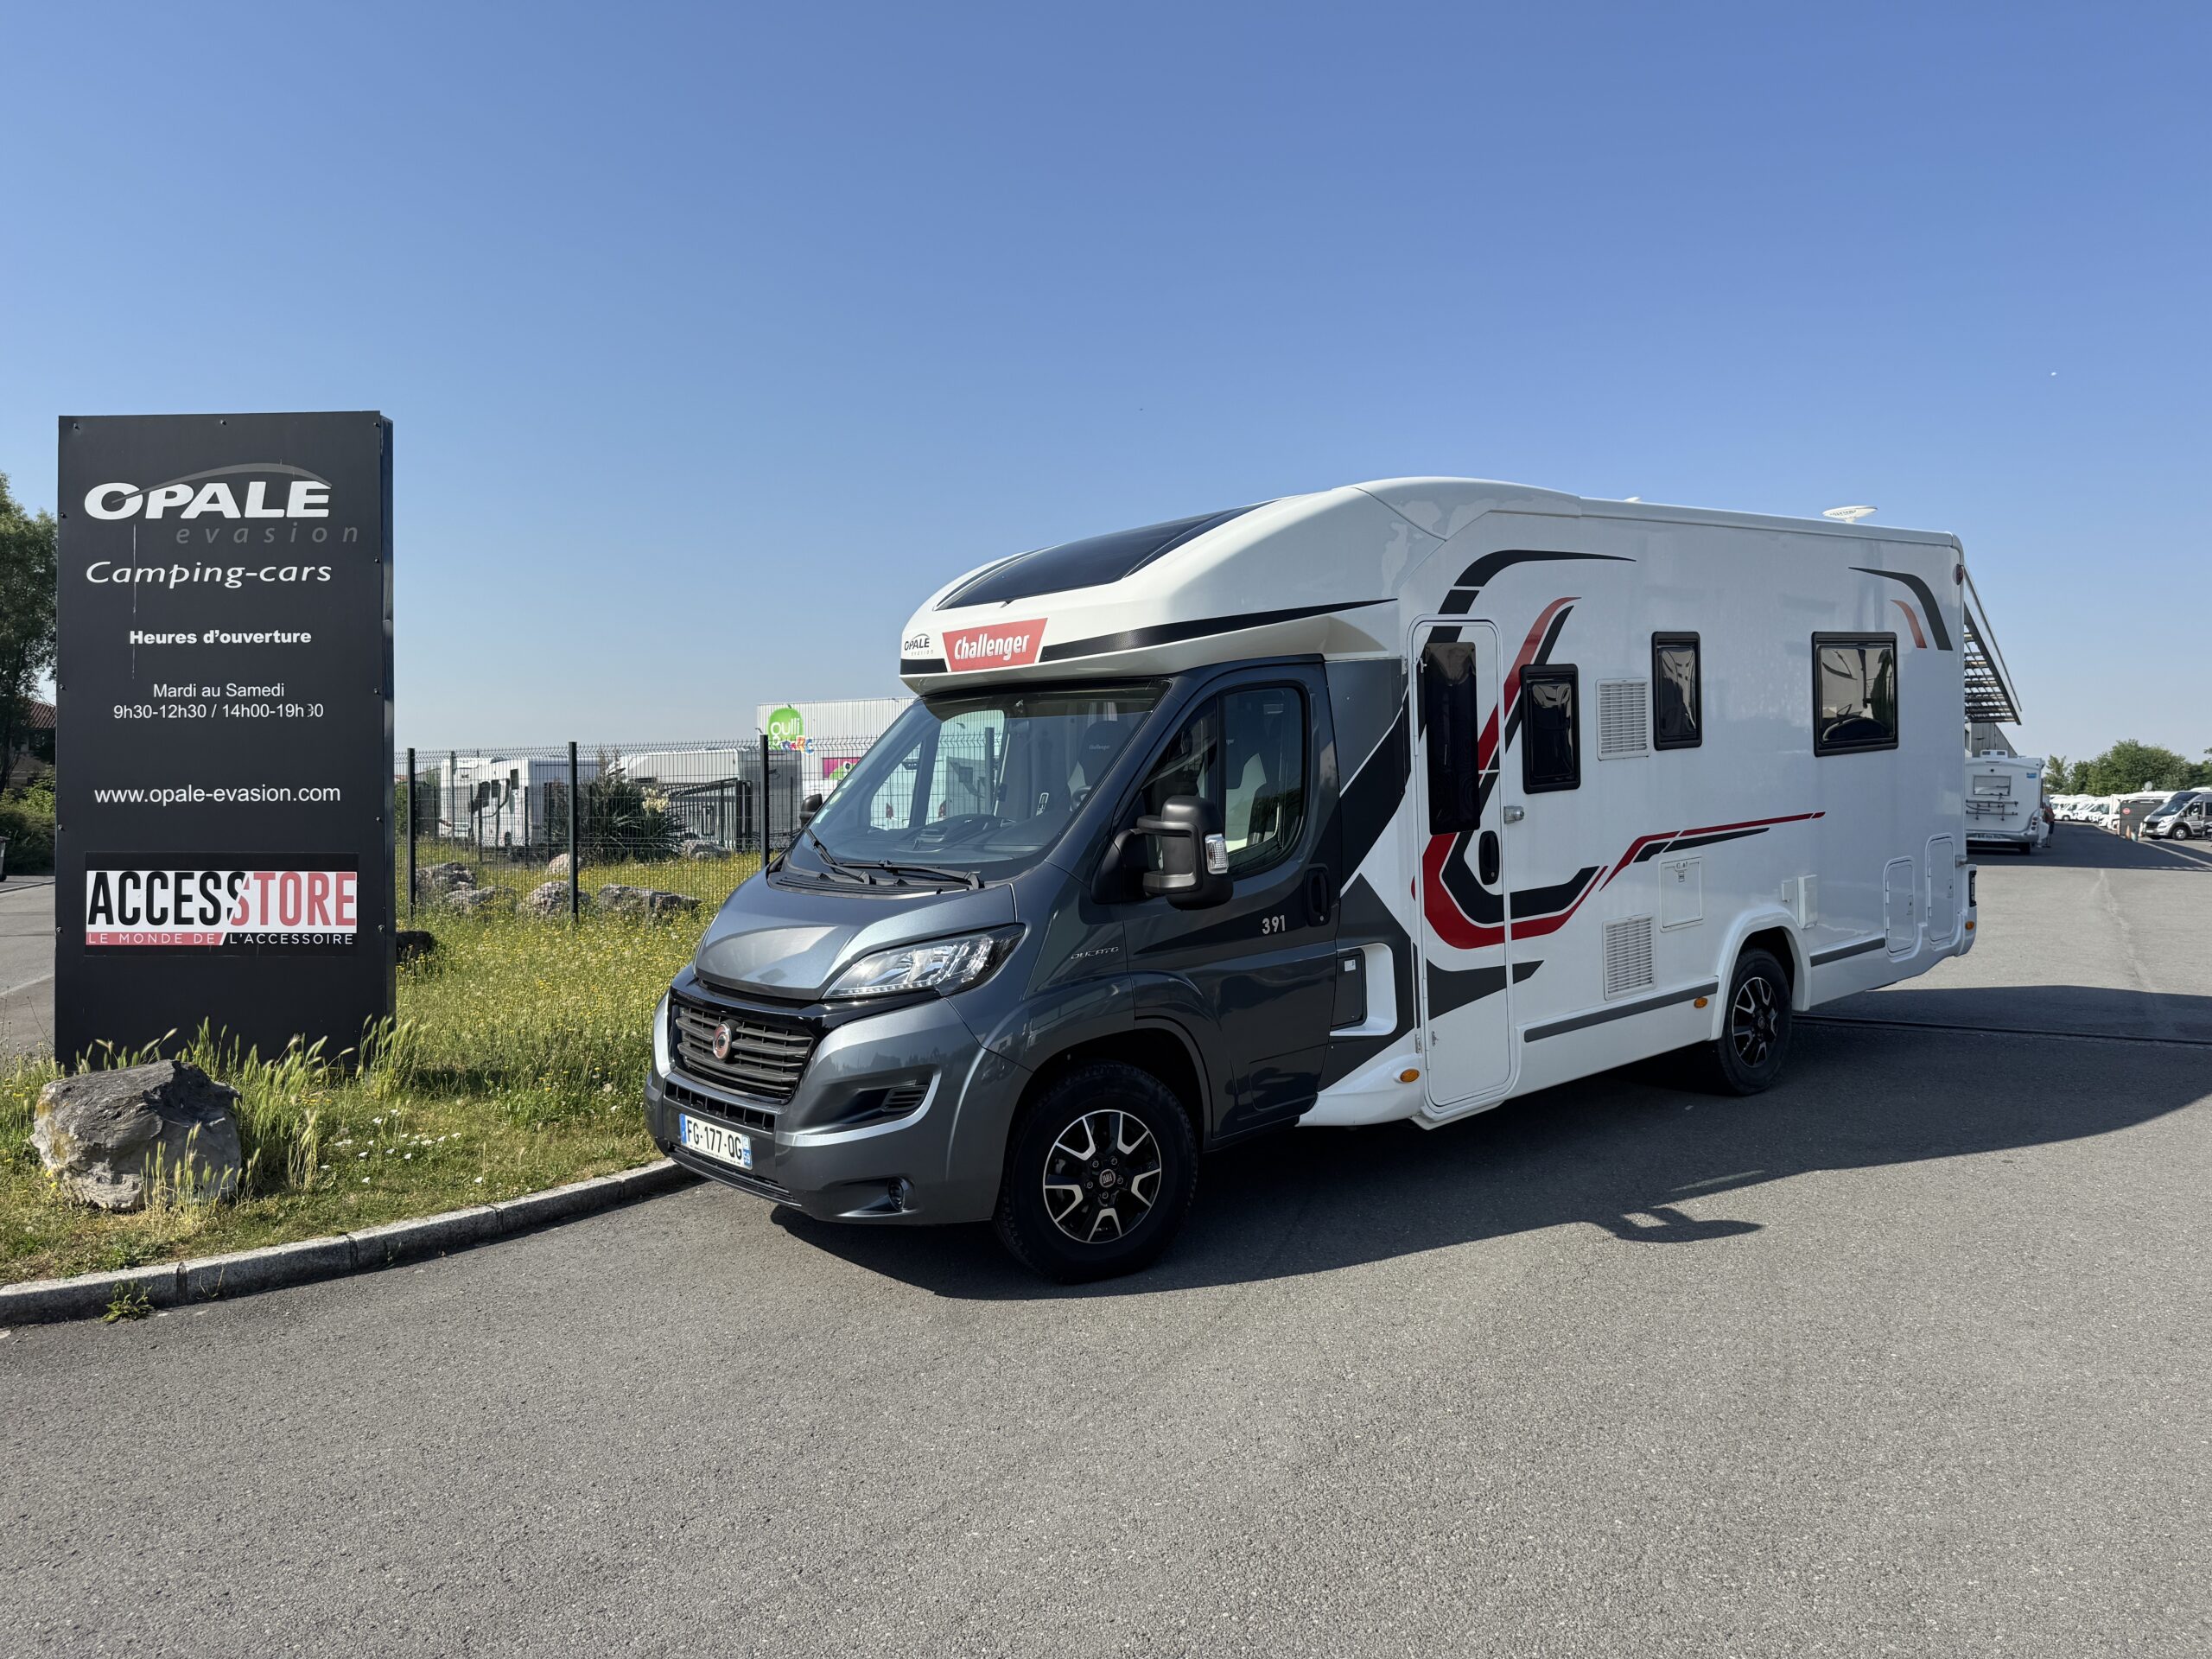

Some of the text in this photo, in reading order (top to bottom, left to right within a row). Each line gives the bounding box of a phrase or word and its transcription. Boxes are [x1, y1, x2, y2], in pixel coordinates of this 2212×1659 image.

[85, 481, 332, 520] OPALE
[175, 522, 358, 544] evasion
[86, 561, 333, 589] Camping-cars
[129, 629, 312, 645] Heures d'ouverture
[904, 637, 931, 652] OPALE
[954, 632, 1030, 661] Challenger
[153, 683, 284, 698] Mardi au Samedi
[113, 704, 207, 719] 9h30-12h30
[212, 704, 217, 719] /
[770, 717, 800, 746] gulli
[94, 784, 341, 806] www.opale-evasion.com
[87, 870, 357, 926] ACCESSTORE
[1262, 914, 1286, 935] 391
[88, 933, 109, 944] LE
[119, 932, 183, 944] MONDE
[194, 933, 216, 944] DE
[1071, 946, 1119, 959] DUCATO
